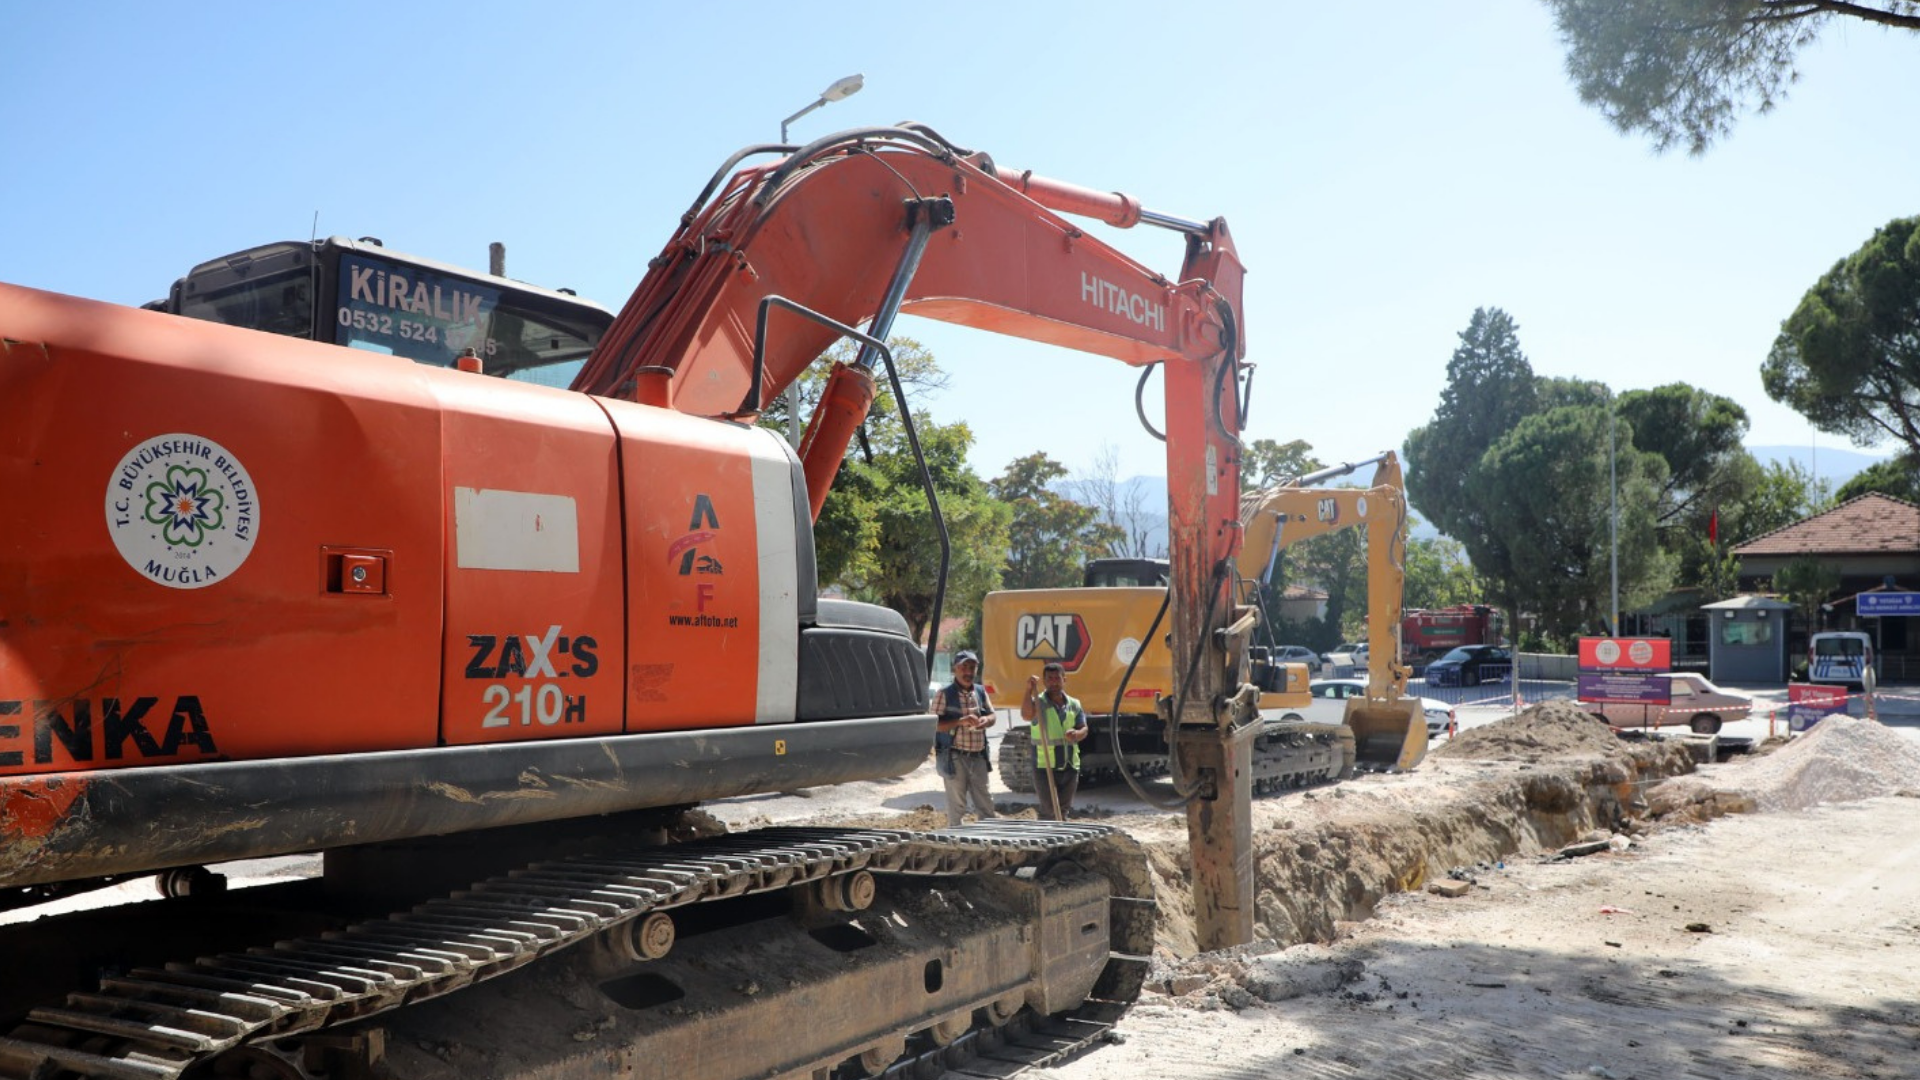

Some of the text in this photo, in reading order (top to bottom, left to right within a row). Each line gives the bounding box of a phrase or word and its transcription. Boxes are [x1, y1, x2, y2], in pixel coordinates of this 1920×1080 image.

[1081, 270, 1165, 332] HITACHI
[338, 307, 392, 335] 0532
[400, 320, 437, 344] 524
[115, 440, 253, 541] T.C. BÜYÜKŞEHİR BELEDİYESİ
[1318, 498, 1335, 522] CAT
[144, 559, 217, 584] MUĞLA
[697, 583, 714, 612] F
[669, 615, 738, 628] www.aftoto.net
[1017, 615, 1073, 658] CAT
